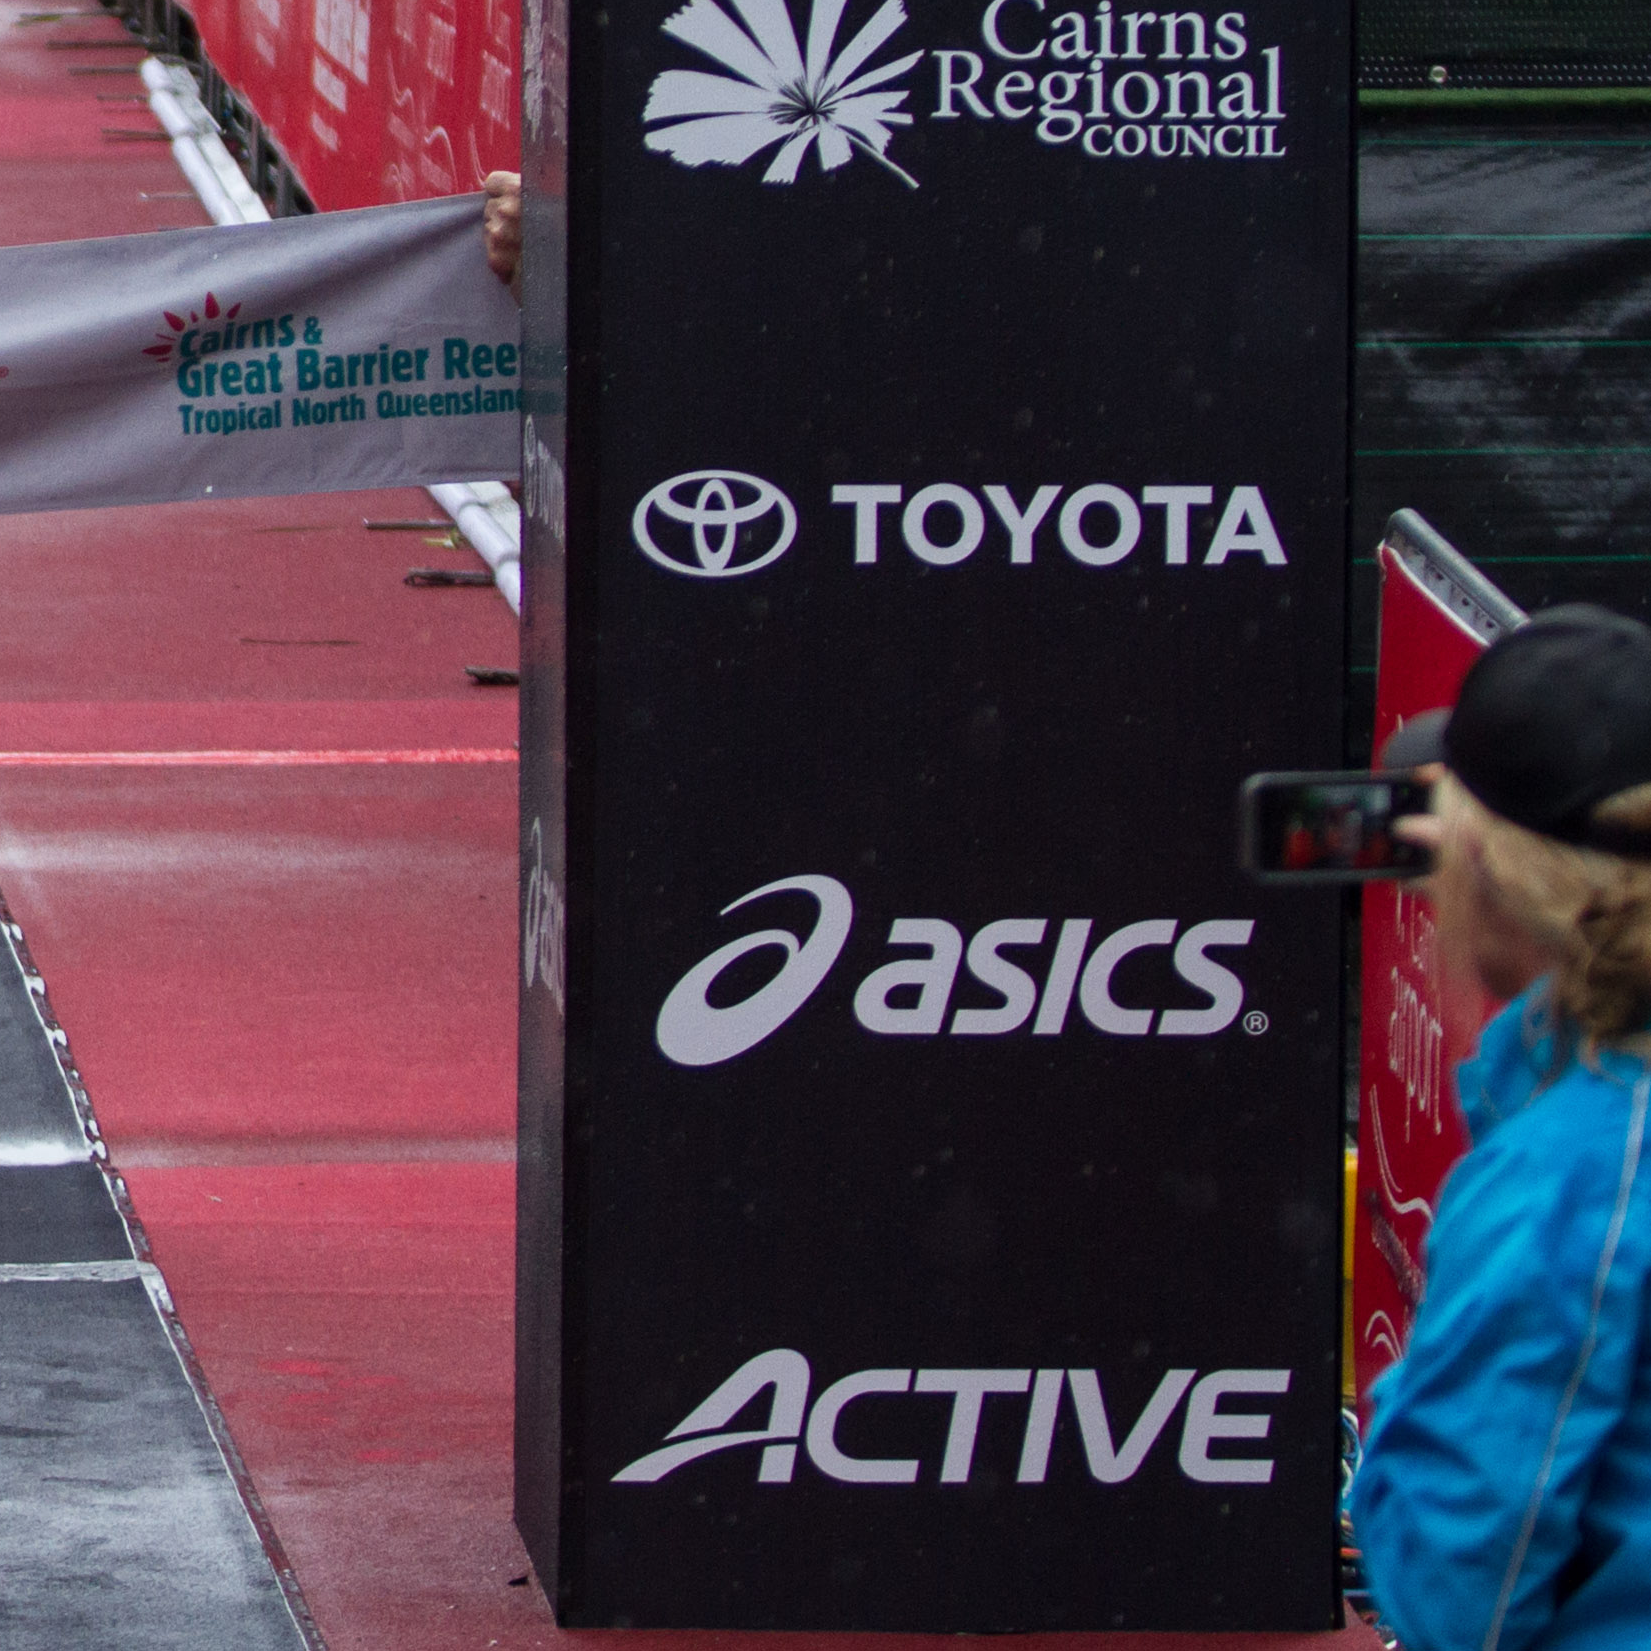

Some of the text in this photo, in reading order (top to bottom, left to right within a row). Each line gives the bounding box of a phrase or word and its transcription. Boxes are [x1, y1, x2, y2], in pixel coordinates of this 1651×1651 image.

[932, 46, 1286, 145] Regional
[1082, 127, 1287, 159] COUNCIL
[177, 337, 520, 398] Great Barrier Ree
[179, 314, 324, 360] Cairns &
[178, 401, 282, 436] Tropical
[292, 394, 367, 427] North
[831, 483, 1288, 566] TOYOTA
[852, 916, 1255, 1038] asics
[611, 1348, 1291, 1483] ACTIVE
